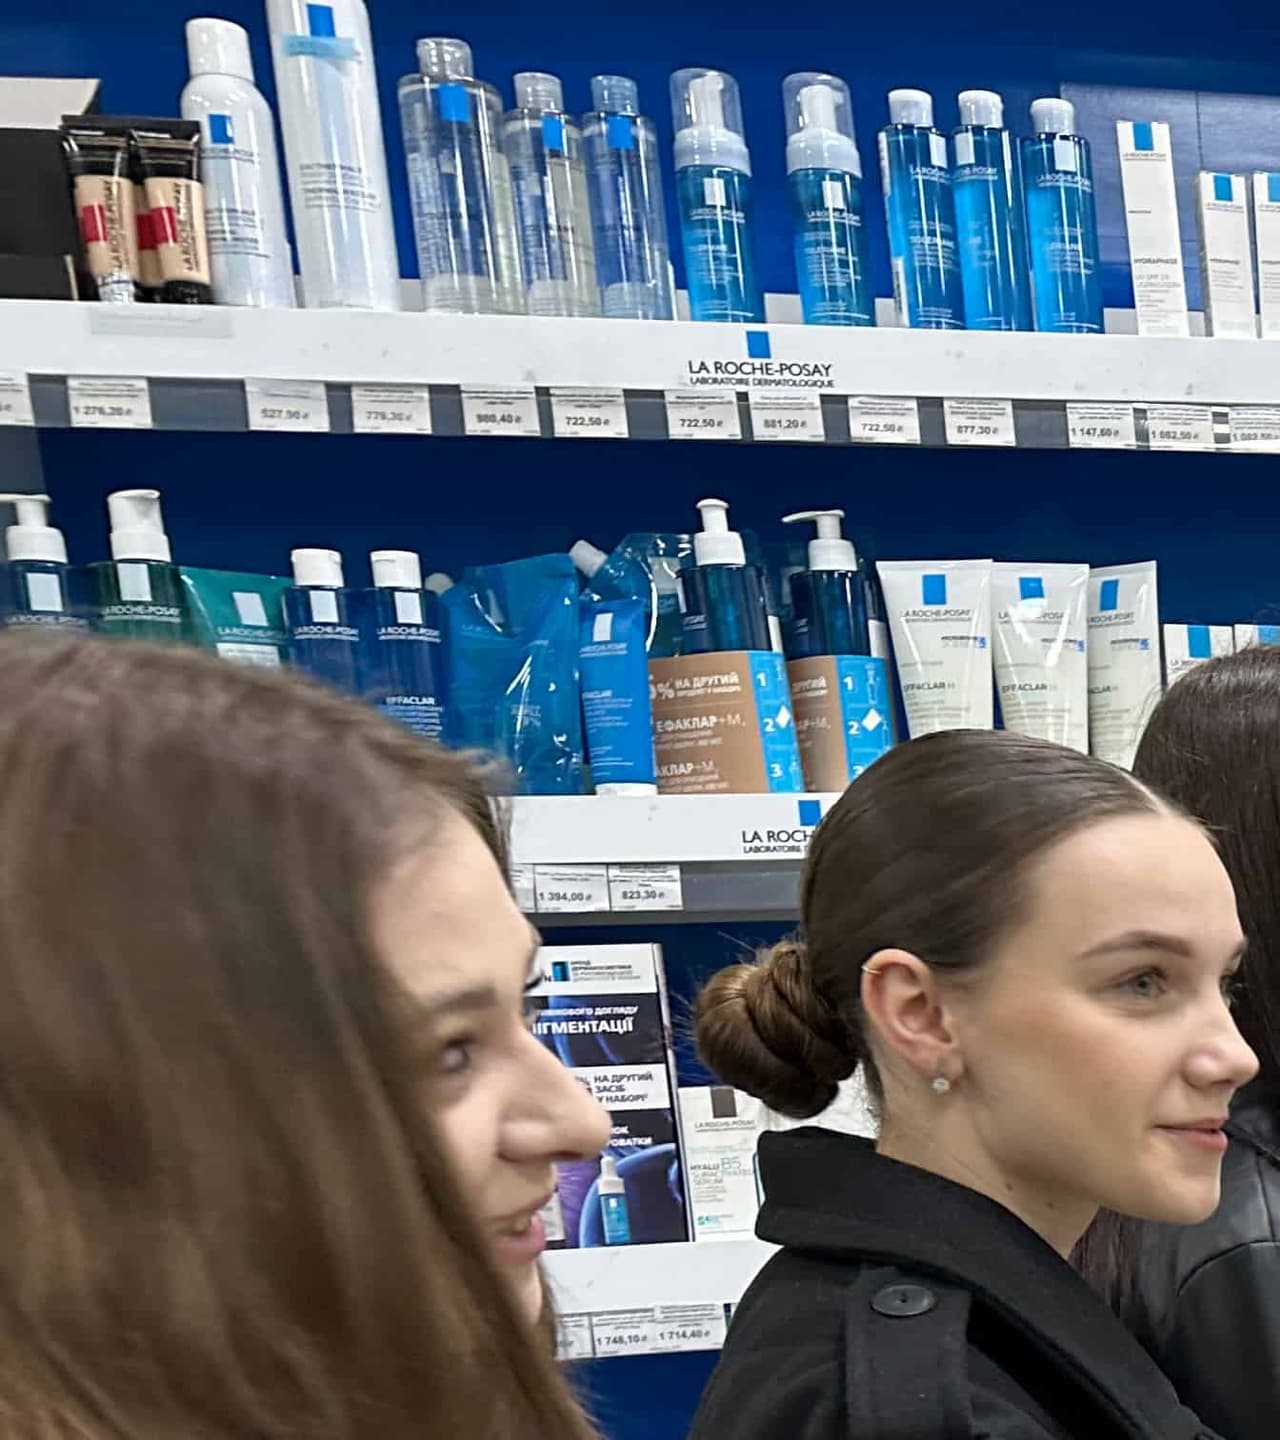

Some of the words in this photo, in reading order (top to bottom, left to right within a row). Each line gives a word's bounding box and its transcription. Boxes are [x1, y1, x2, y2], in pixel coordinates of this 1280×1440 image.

[688, 360, 710, 376] LA
[714, 361, 832, 378] ROCHE-POSAY
[757, 674, 766, 687] 1
[844, 677, 853, 690] 1
[764, 720, 774, 732] 2
[849, 722, 860, 734] 2
[770, 765, 782, 777] 3
[742, 830, 761, 843] LA
